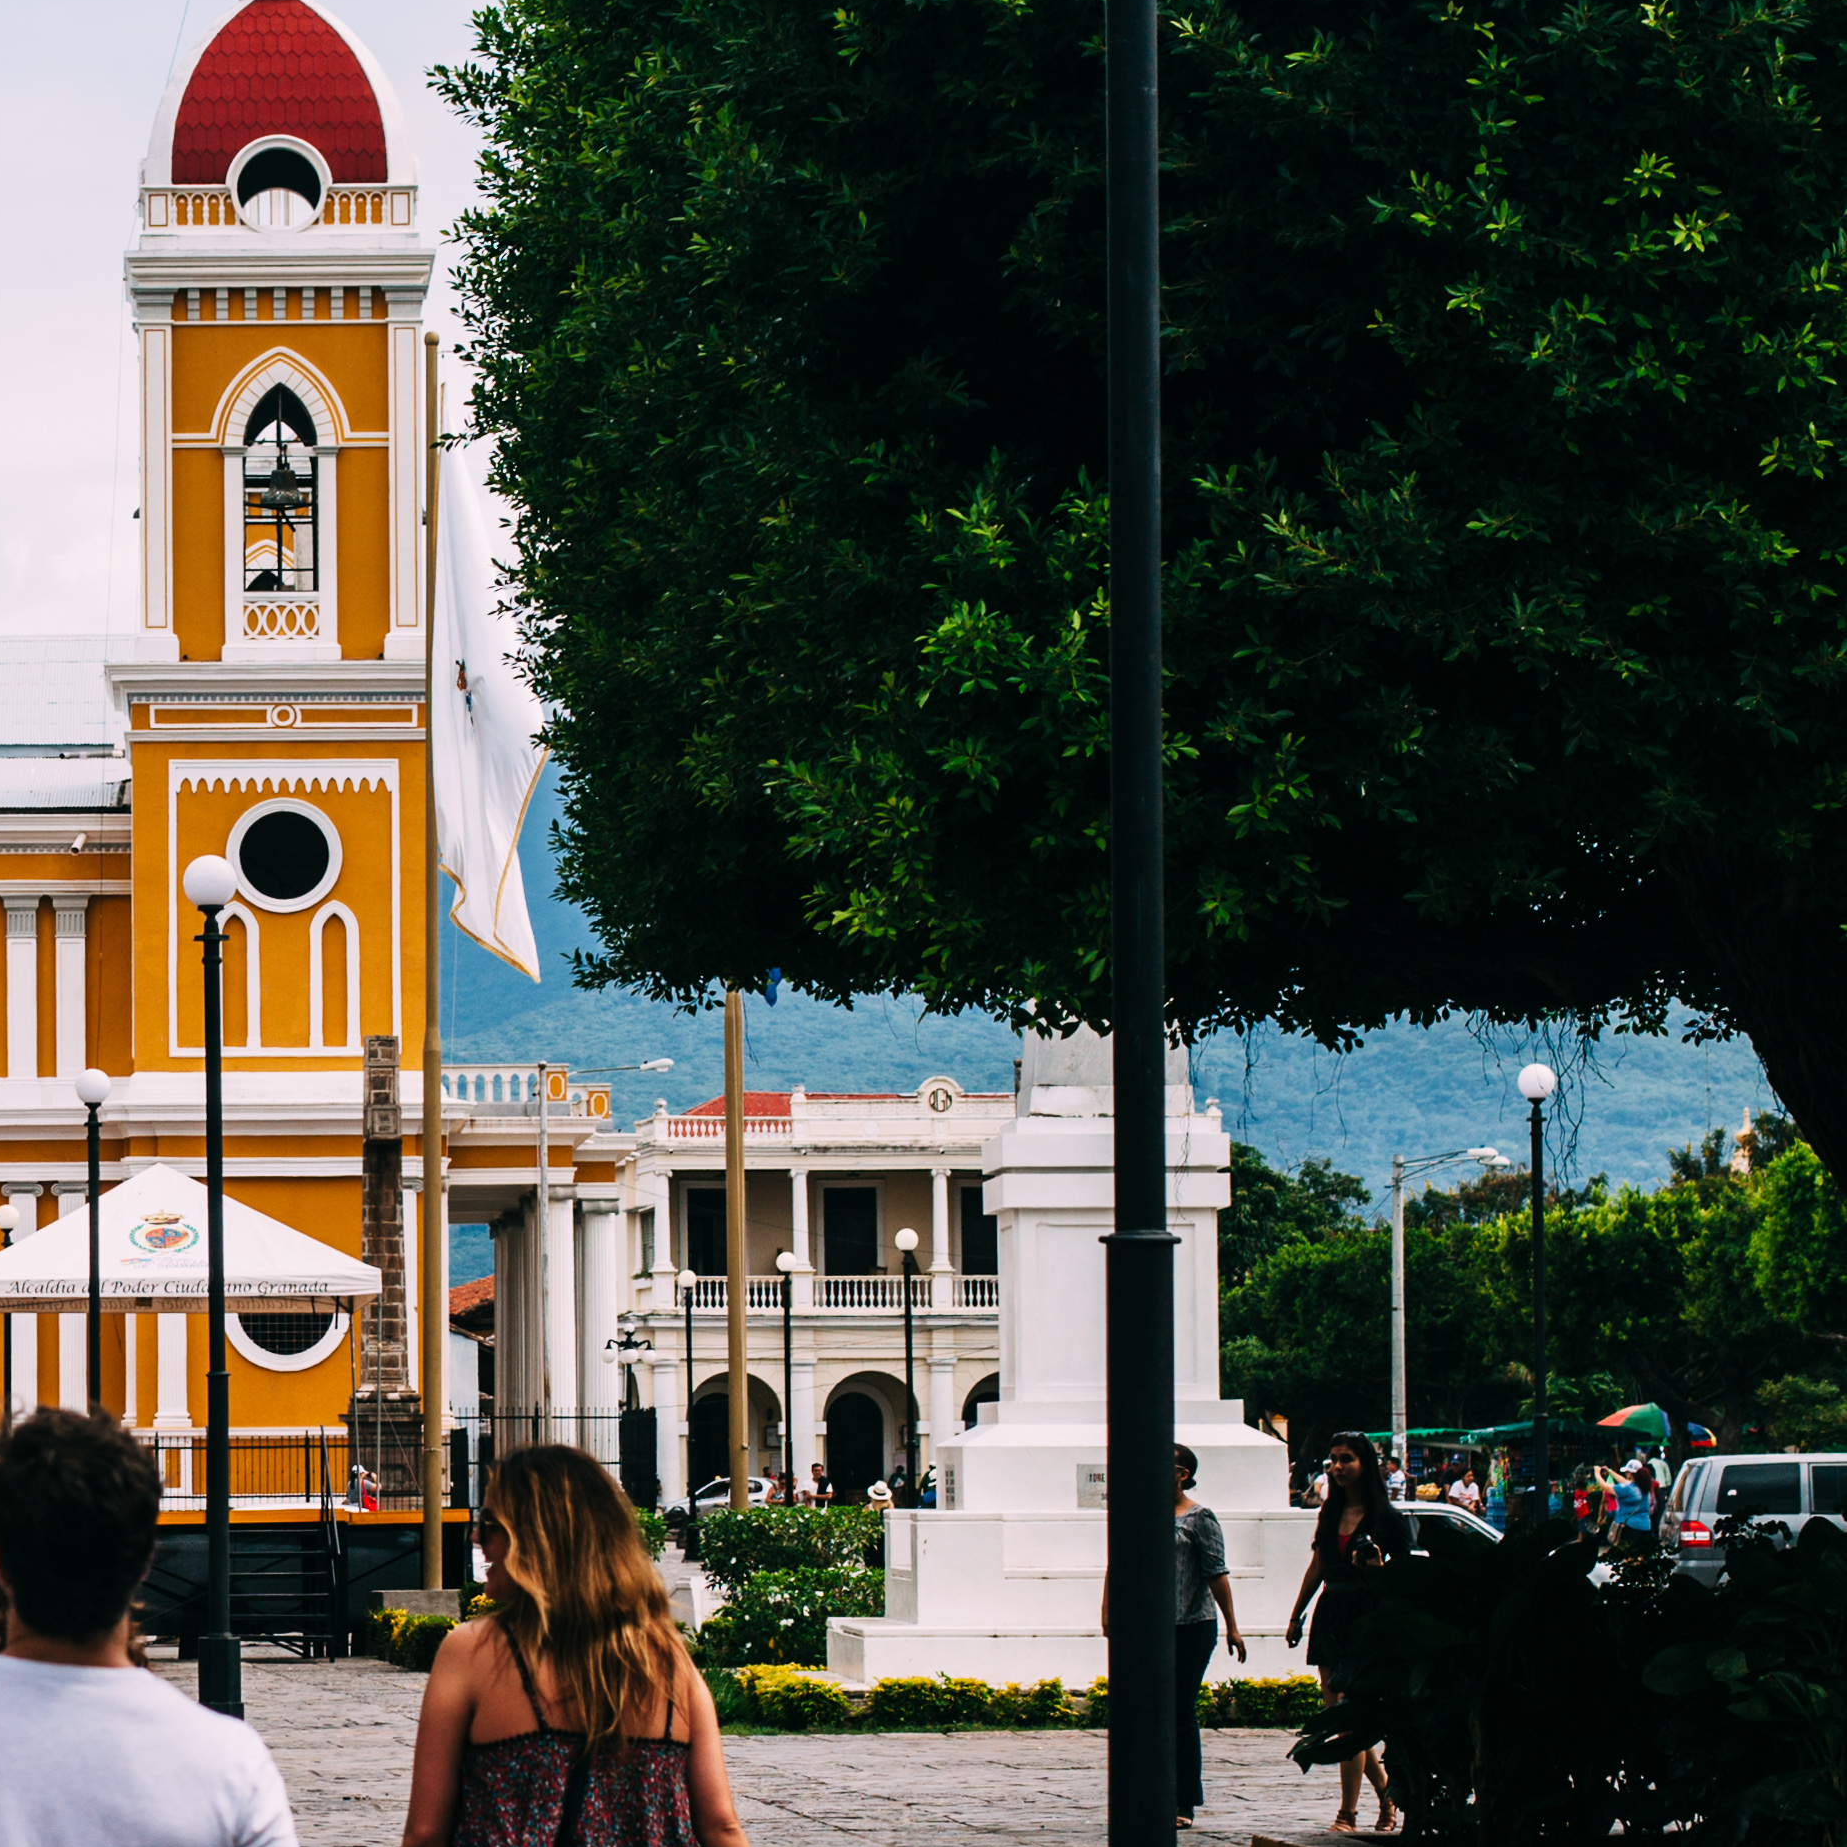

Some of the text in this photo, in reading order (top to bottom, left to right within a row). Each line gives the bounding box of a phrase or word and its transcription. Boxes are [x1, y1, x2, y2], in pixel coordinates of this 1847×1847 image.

[5, 1279, 328, 1297] Alcaldia dl Poder Ciudaano Granada
